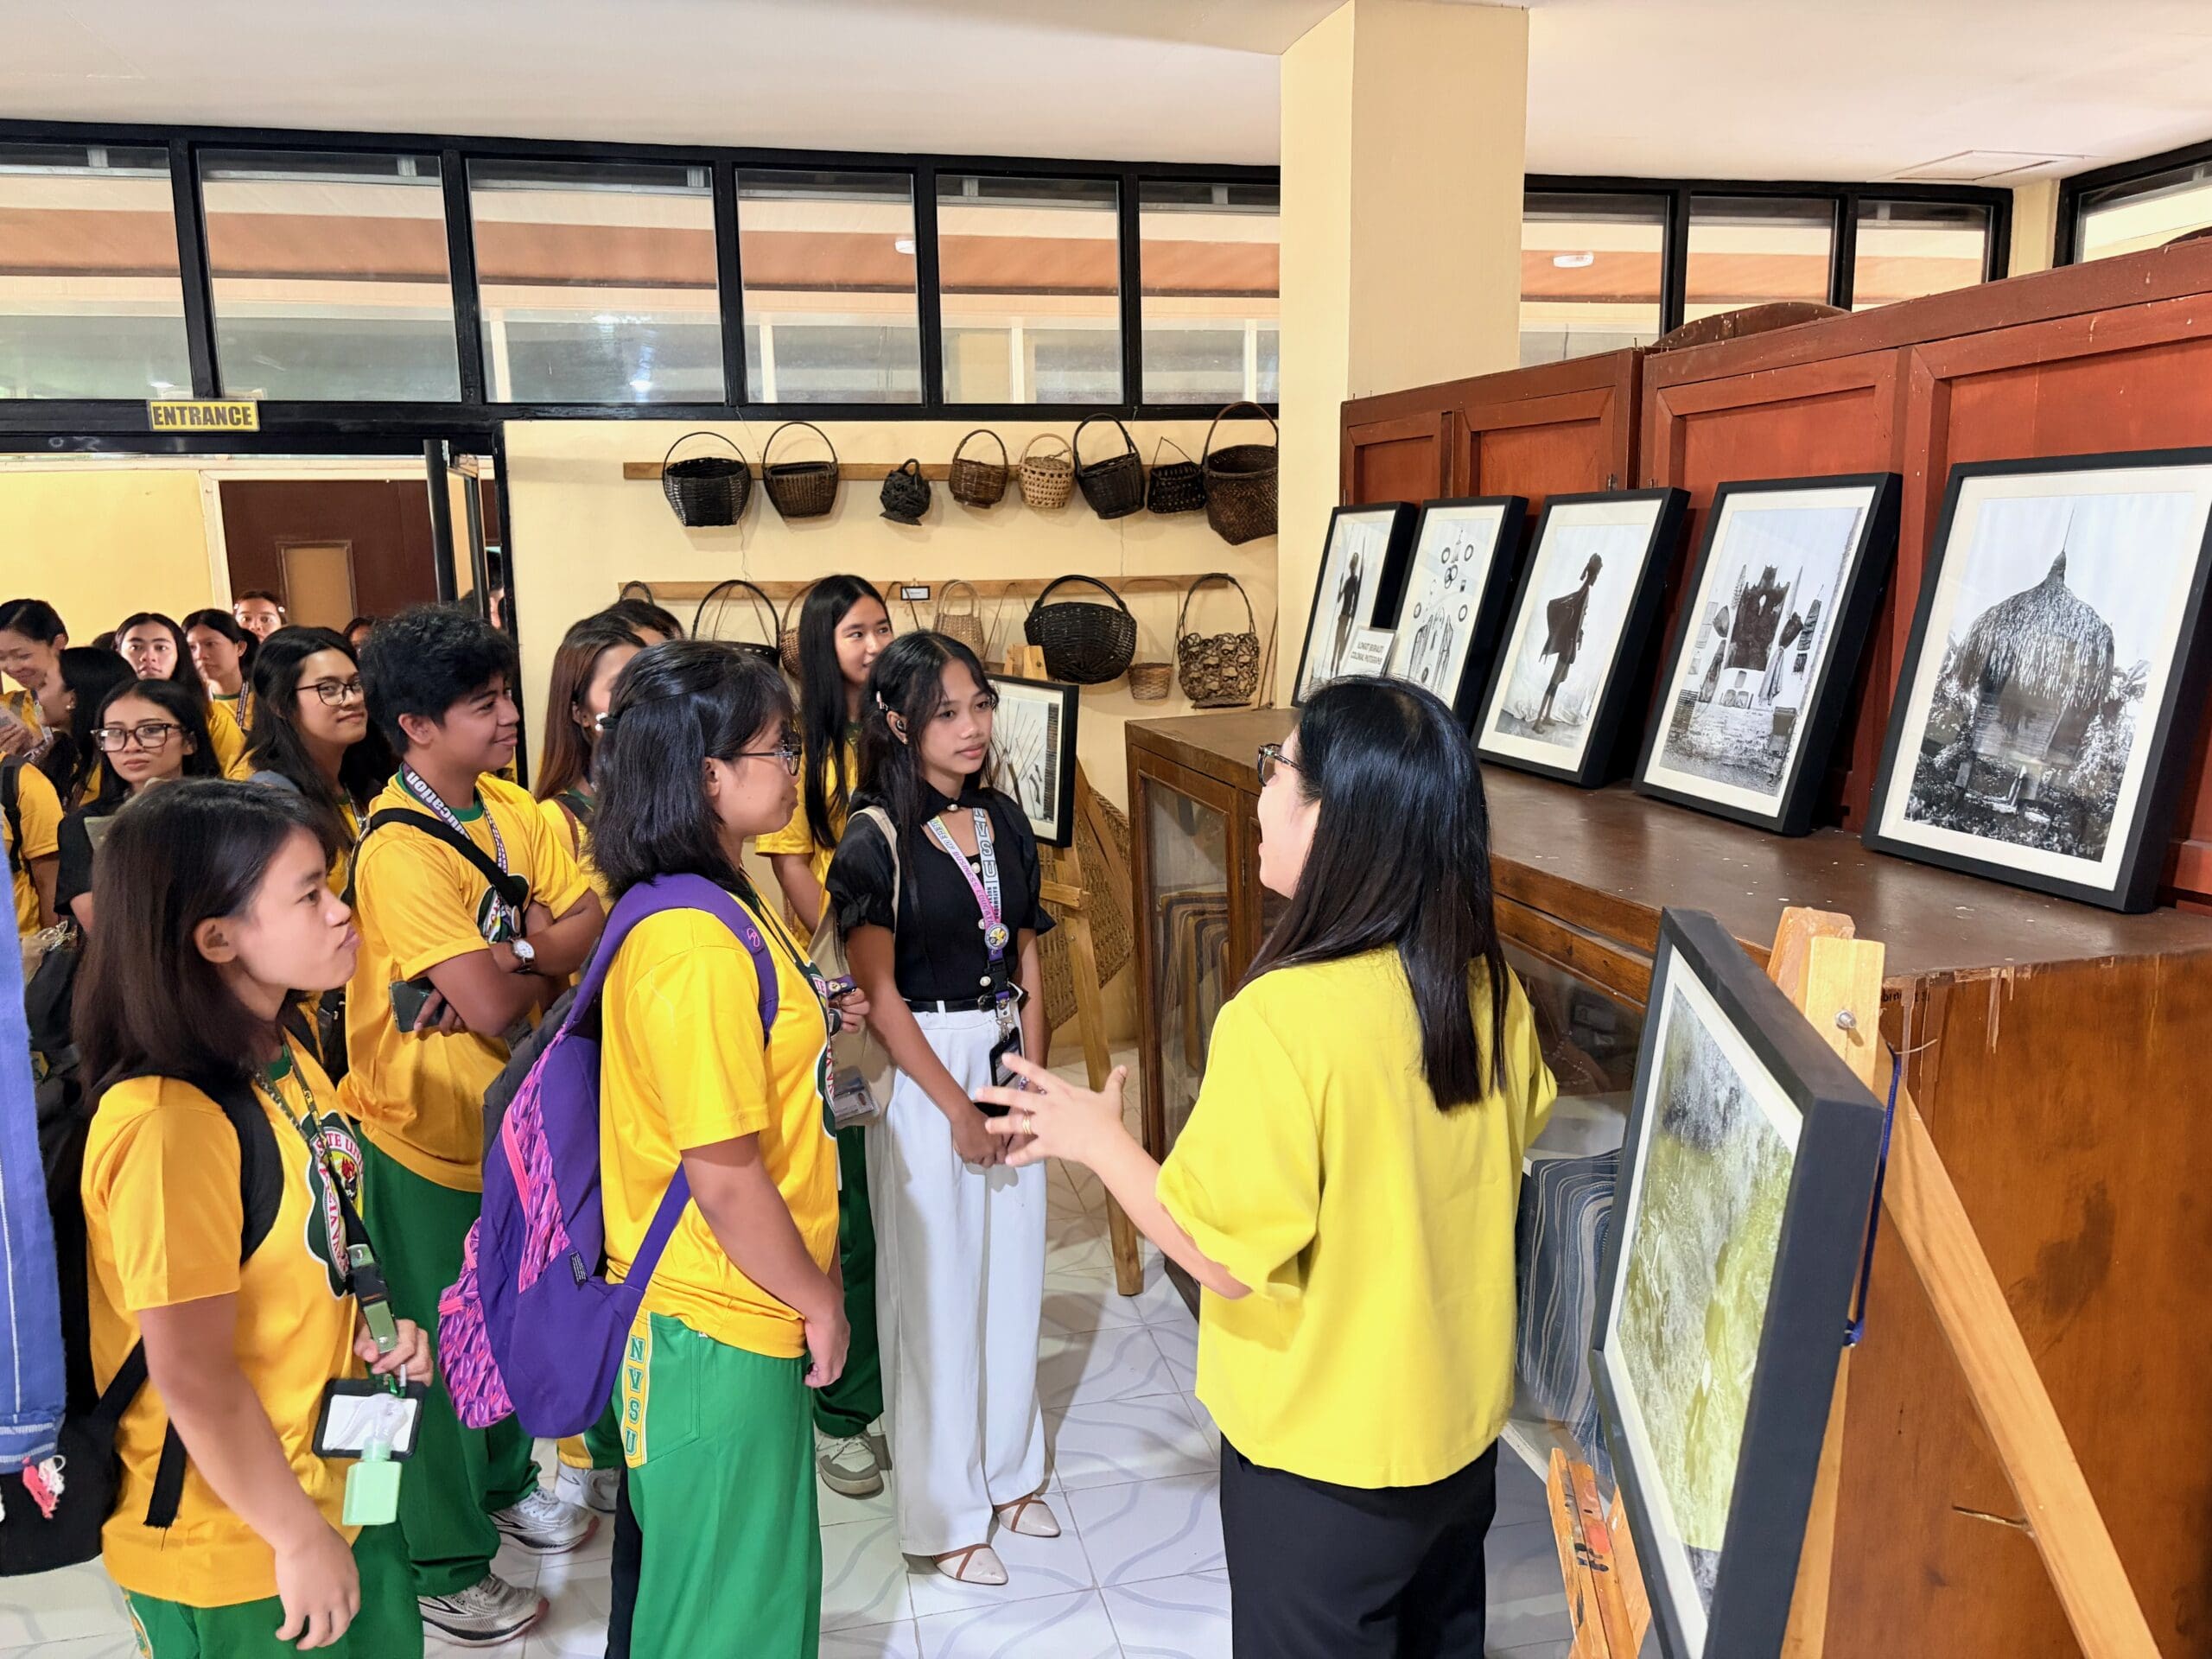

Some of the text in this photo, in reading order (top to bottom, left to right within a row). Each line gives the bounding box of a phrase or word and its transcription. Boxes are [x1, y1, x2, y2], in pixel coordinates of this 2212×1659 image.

[152, 405, 253, 426] ENTRANCE
[406, 771, 471, 841] ducation
[952, 851, 978, 887] BUSINESS
[974, 807, 997, 879] NVSU
[626, 1336, 645, 1456] NVSU
